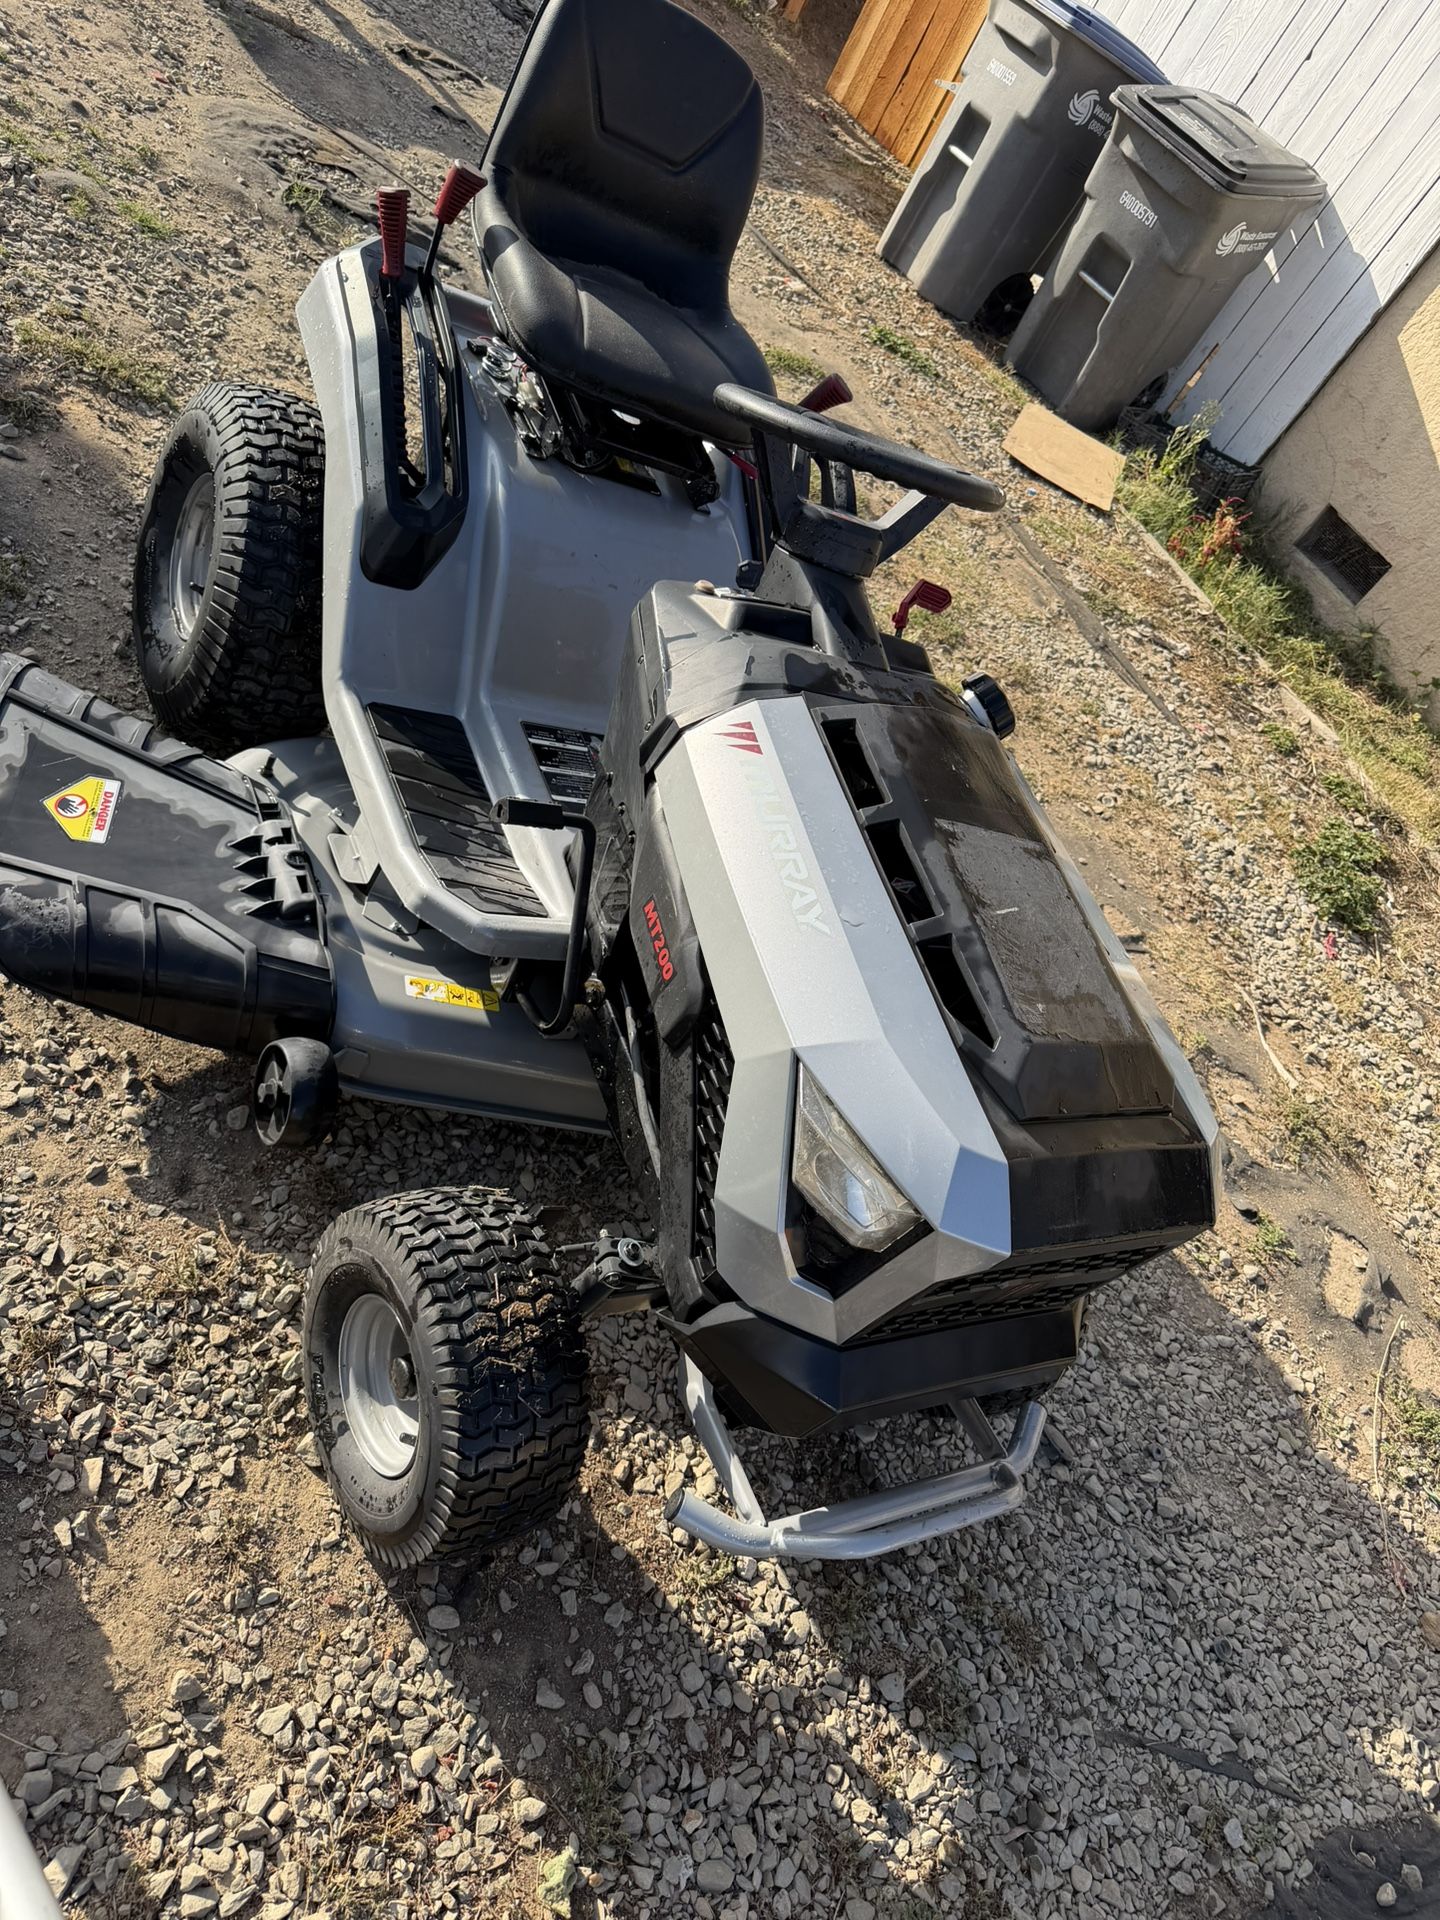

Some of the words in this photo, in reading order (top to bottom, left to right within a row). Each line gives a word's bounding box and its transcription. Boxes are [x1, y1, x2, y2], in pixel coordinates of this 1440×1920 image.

[1093, 104, 1112, 124] Waste
[1119, 190, 1159, 229] 640005791
[94, 791, 114, 831] DANGER
[643, 899, 674, 981] MT200
